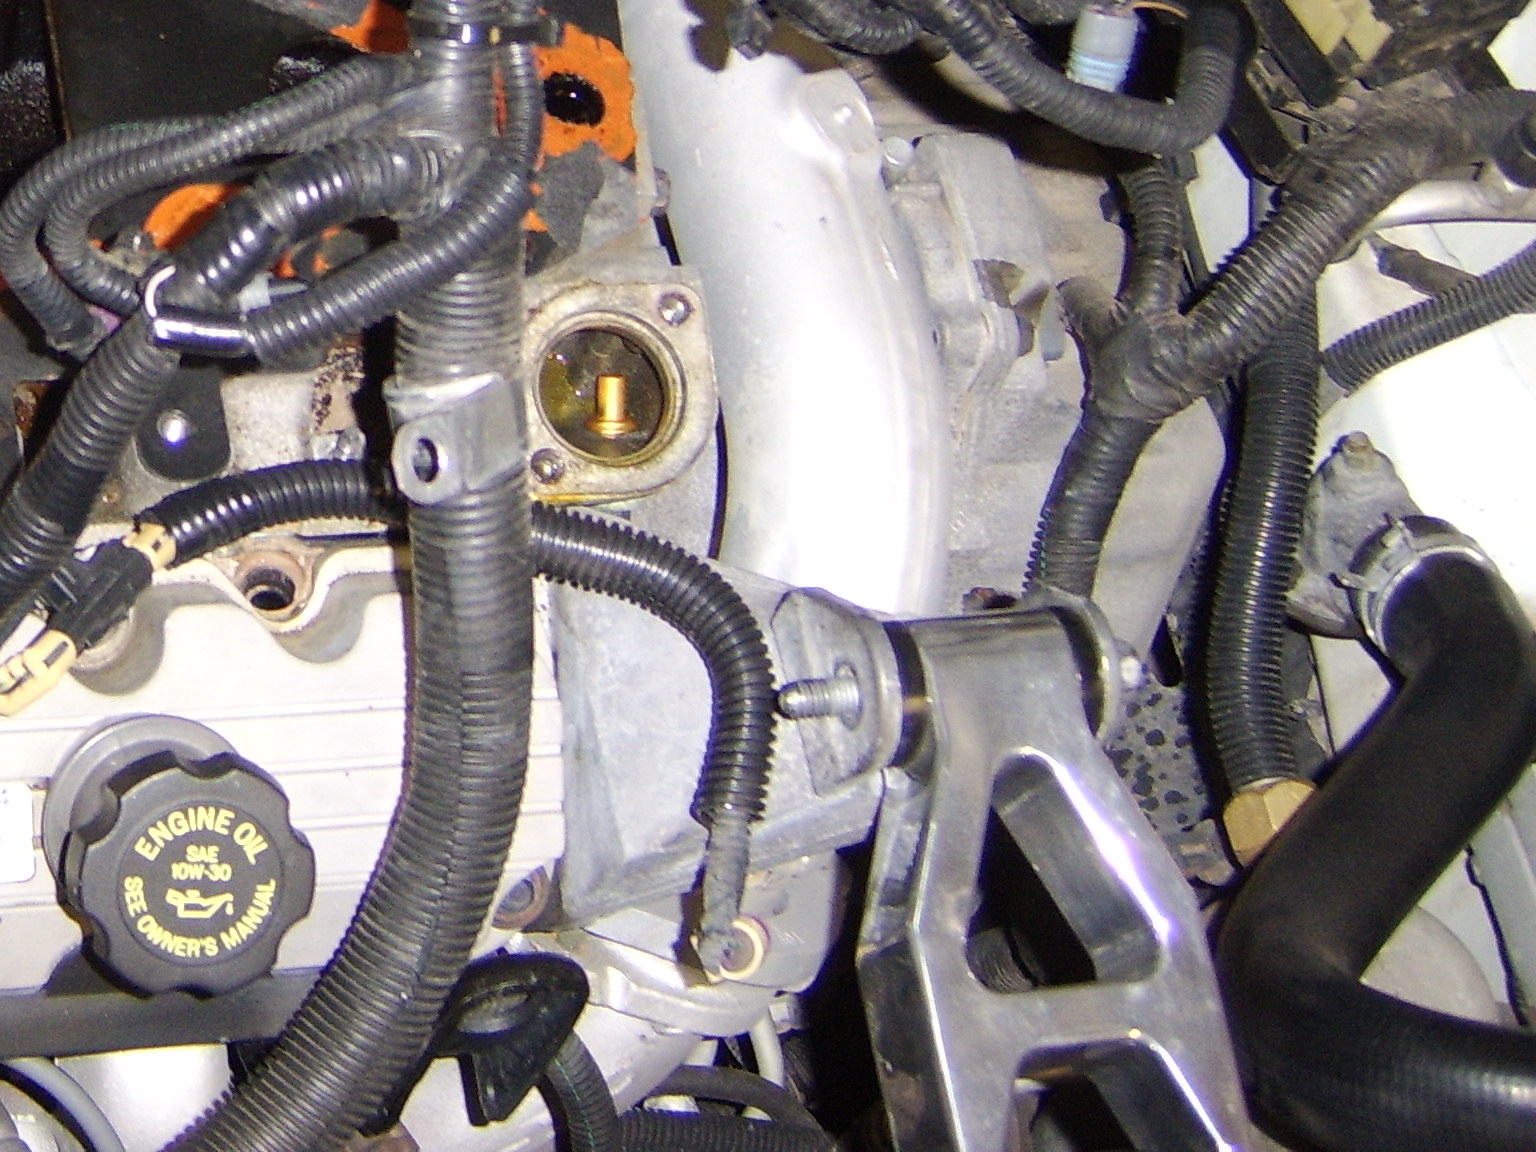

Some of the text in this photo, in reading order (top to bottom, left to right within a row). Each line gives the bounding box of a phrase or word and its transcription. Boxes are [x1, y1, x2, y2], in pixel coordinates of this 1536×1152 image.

[134, 805, 270, 866] ENGINE OIL
[185, 844, 220, 863] SAE
[170, 862, 233, 882] 10W-30
[123, 874, 277, 959] SEE OWNER'S MANUAL
